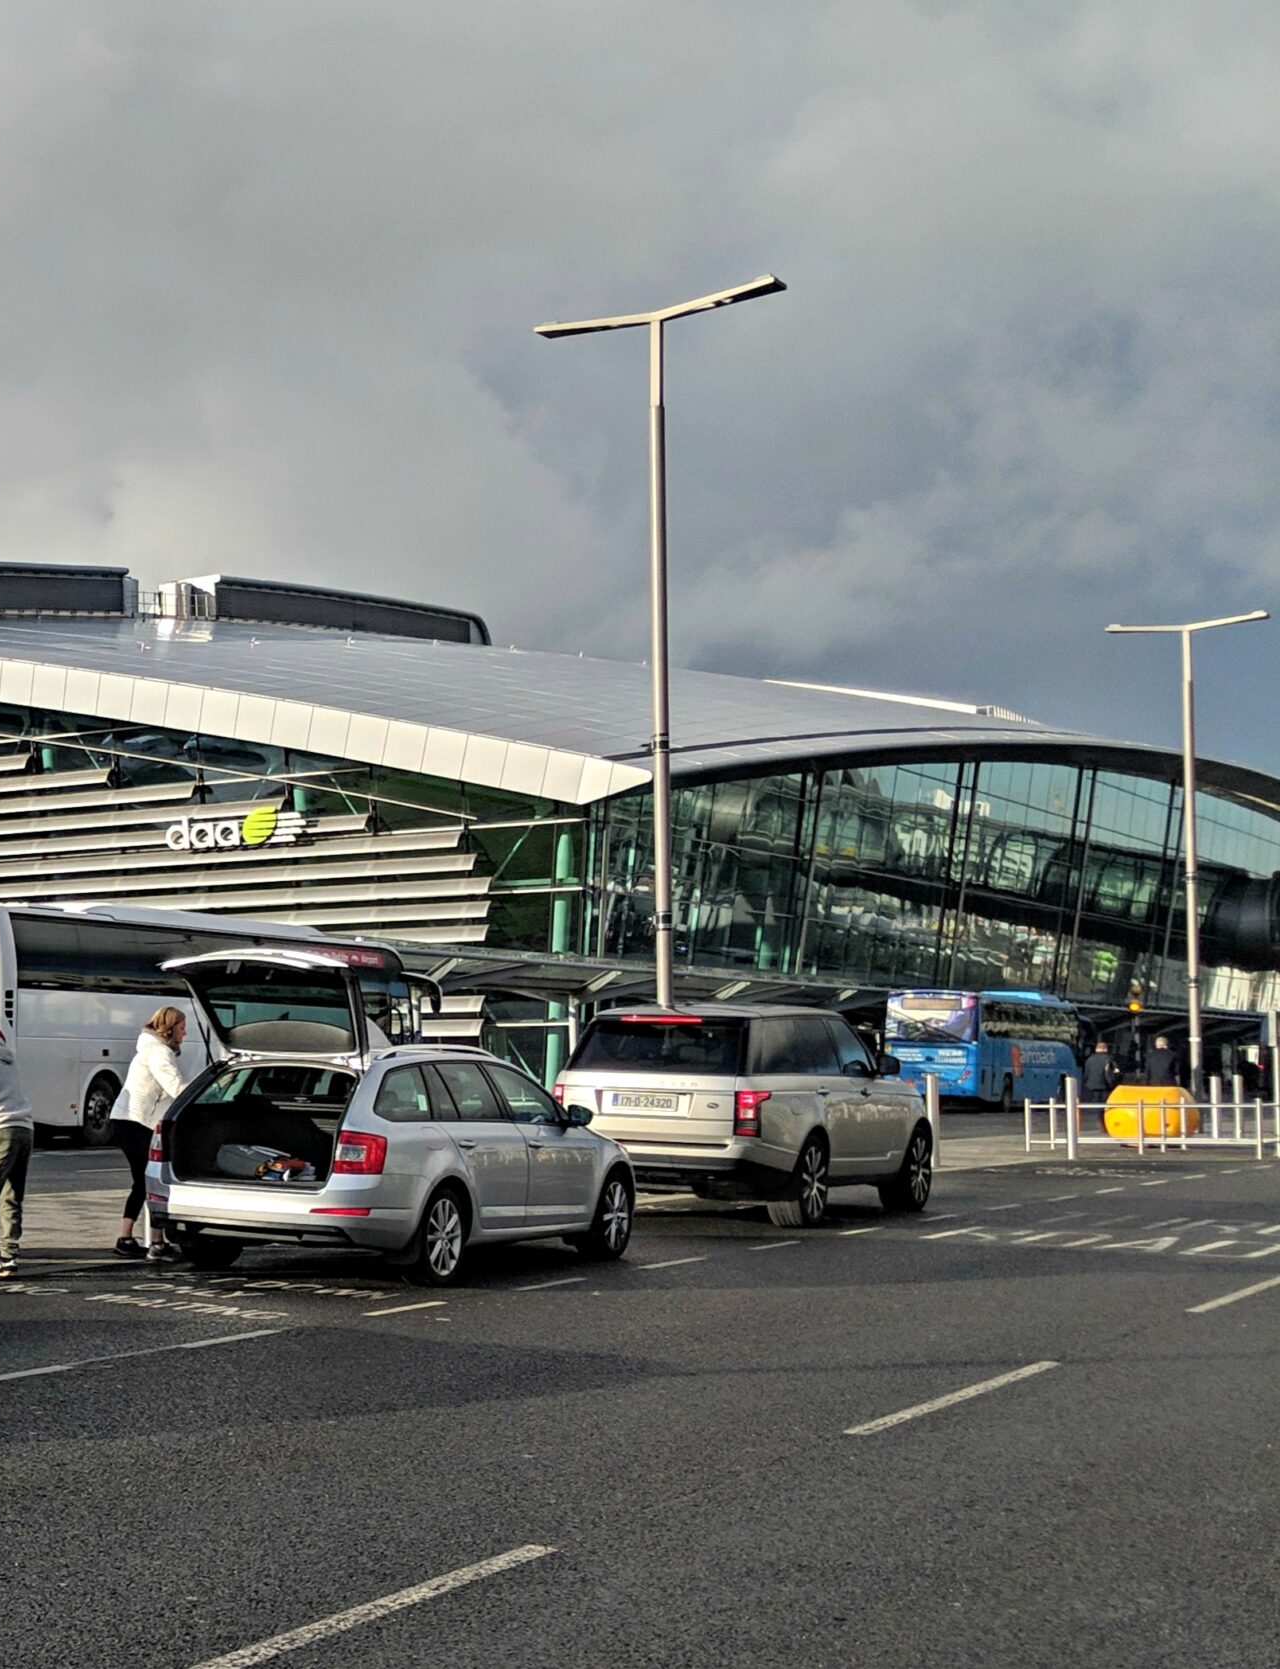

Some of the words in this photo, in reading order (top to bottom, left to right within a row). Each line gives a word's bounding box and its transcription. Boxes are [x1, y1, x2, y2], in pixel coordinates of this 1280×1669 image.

[165, 815, 241, 850] daa
[1019, 1050, 1057, 1065] aircoach
[620, 1095, 673, 1109] 171-D-24320
[130, 1283, 266, 1299] ONLY
[83, 1293, 289, 1320] WAITING
